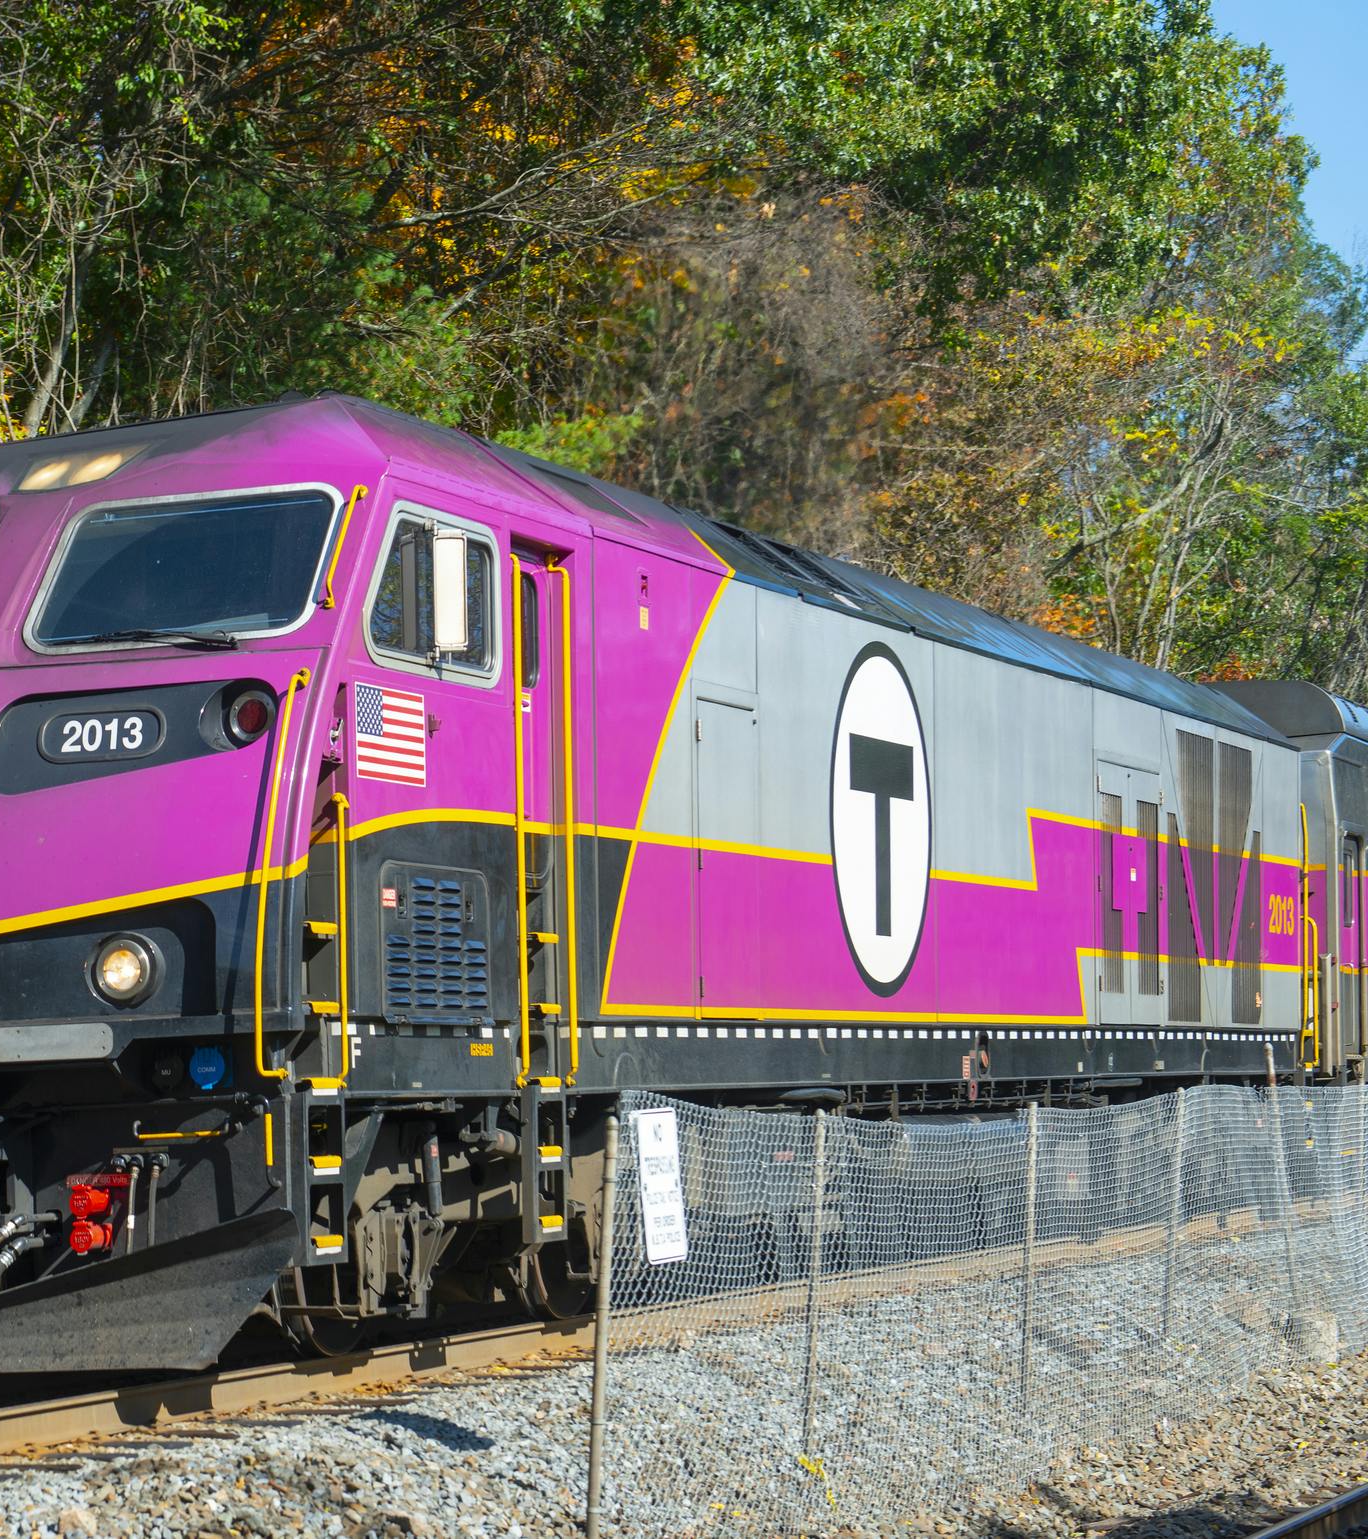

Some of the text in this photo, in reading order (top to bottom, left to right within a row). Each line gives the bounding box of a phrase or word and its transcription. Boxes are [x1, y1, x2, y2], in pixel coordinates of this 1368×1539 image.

[61, 716, 143, 753] 2013
[849, 732, 914, 937] T
[1268, 893, 1295, 936] 2013
[197, 1066, 216, 1074] COMM
[351, 1037, 362, 1068] F
